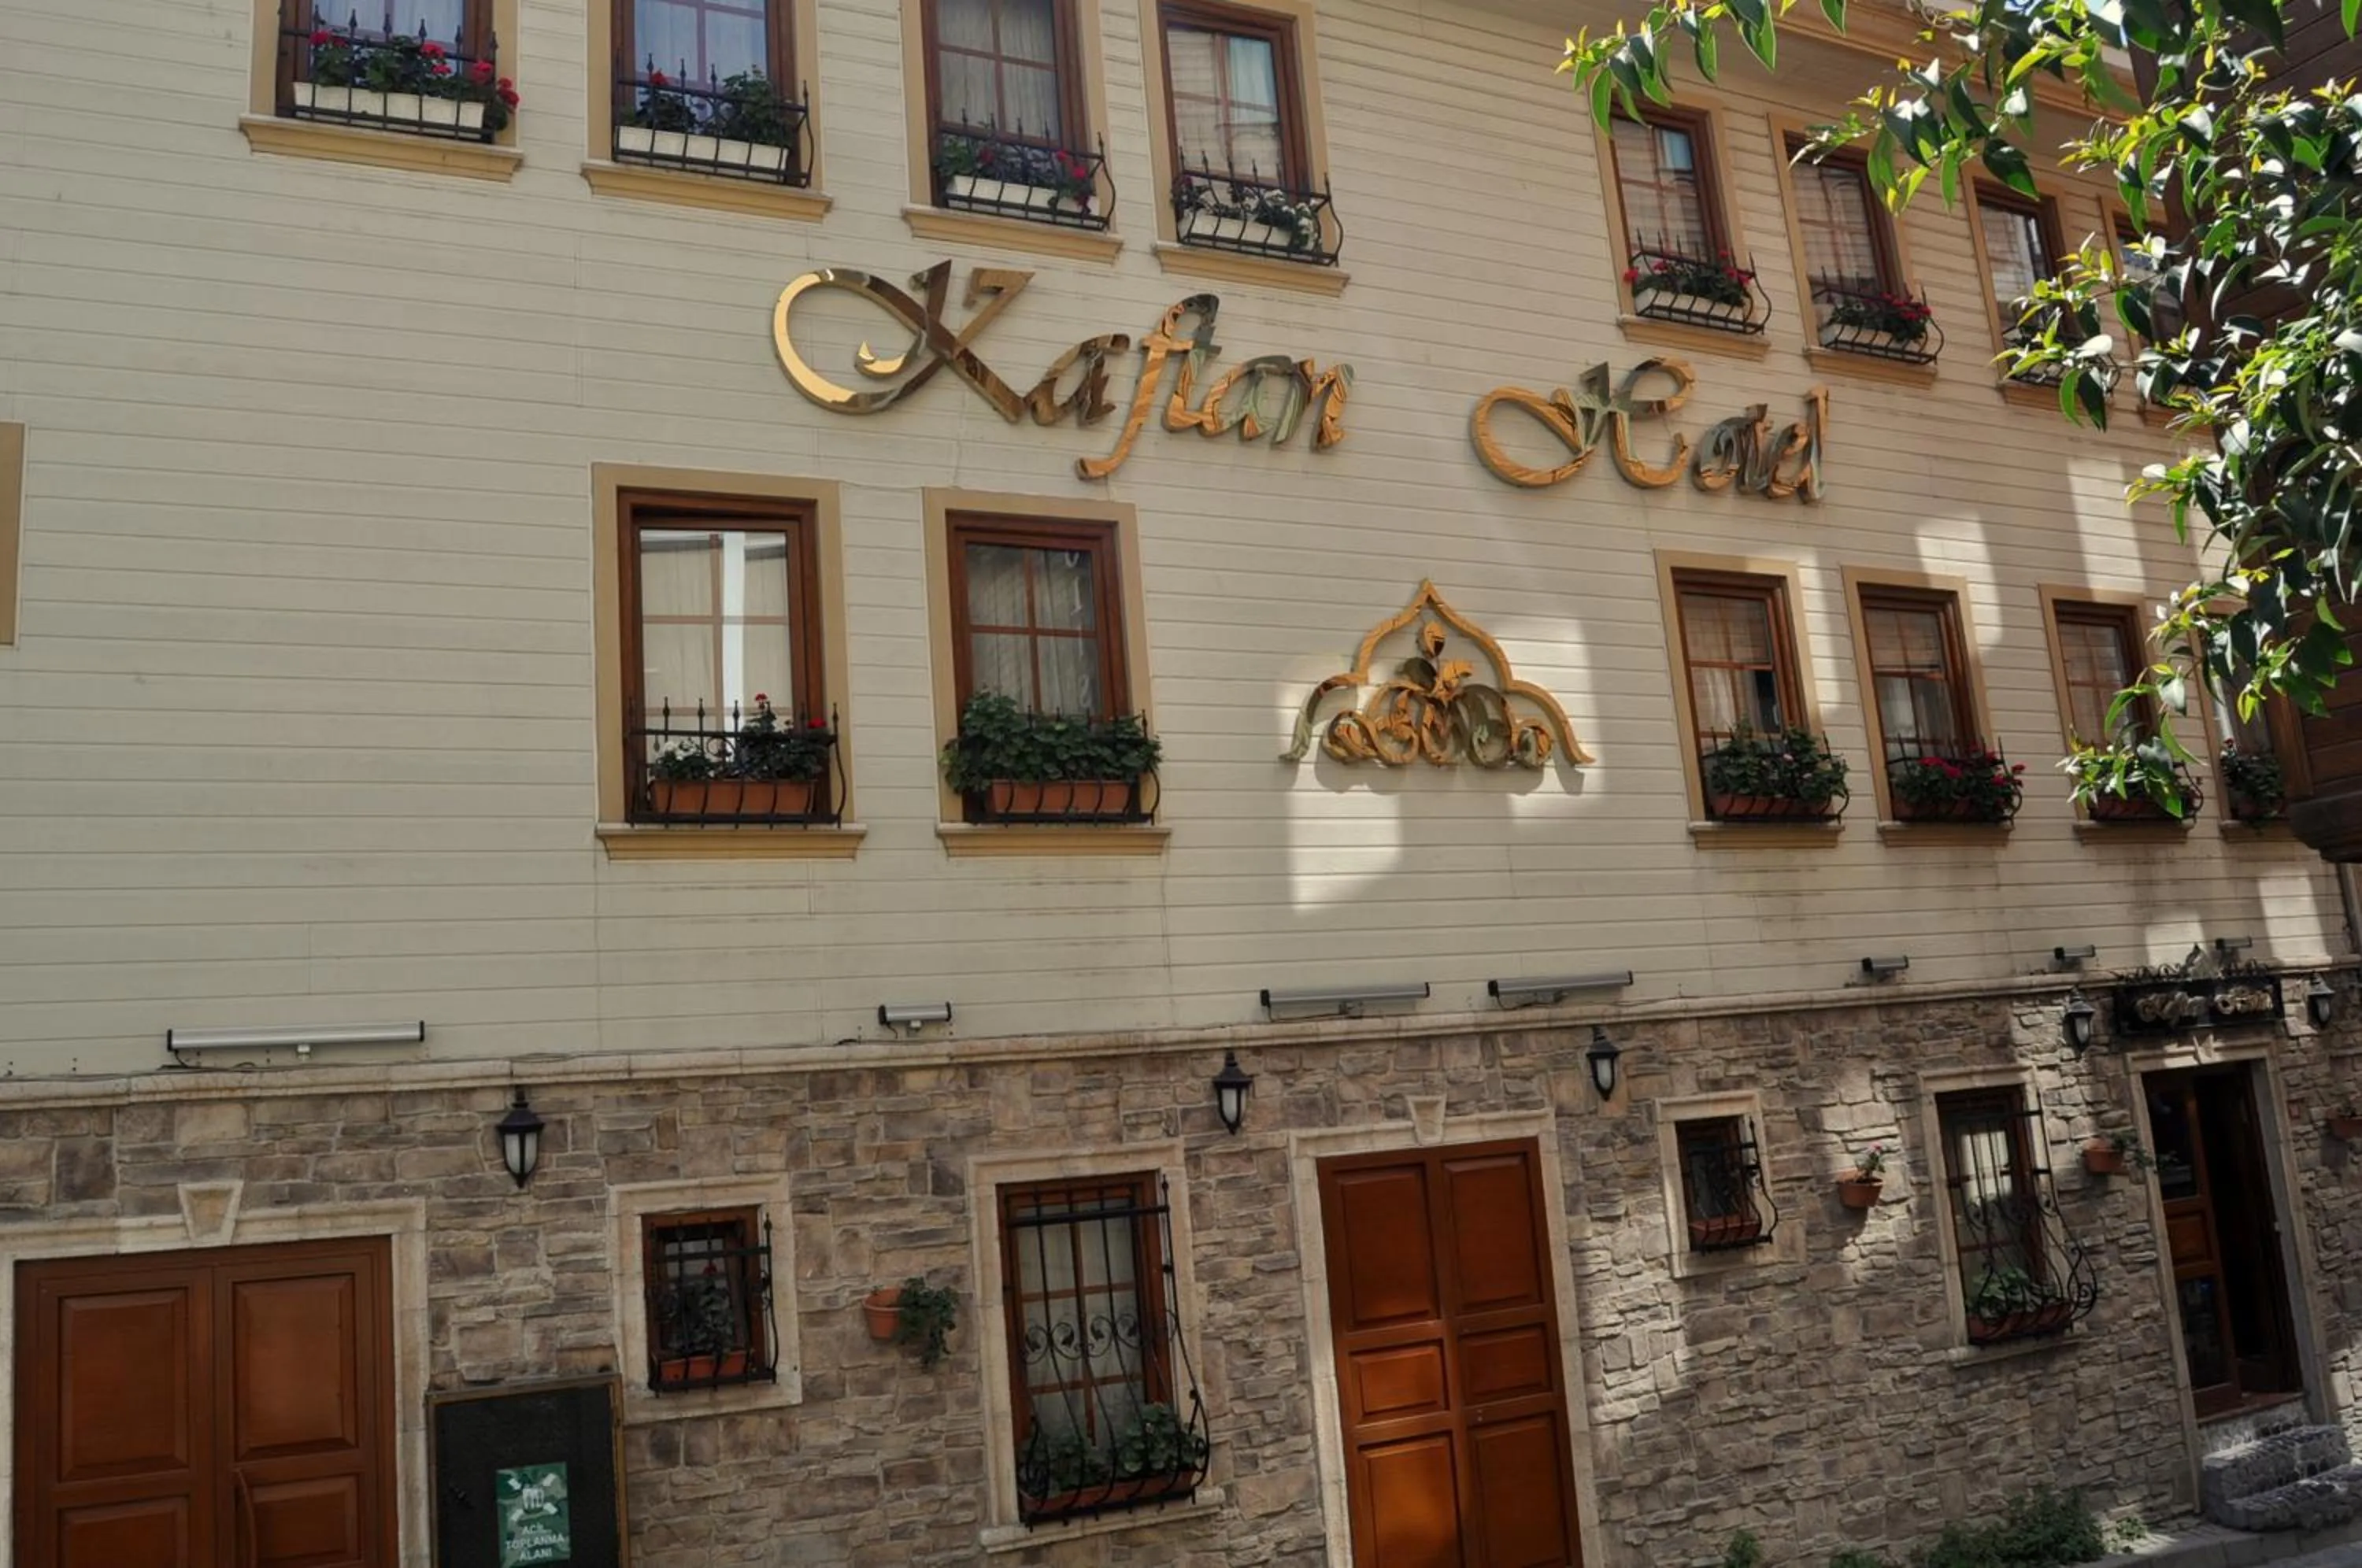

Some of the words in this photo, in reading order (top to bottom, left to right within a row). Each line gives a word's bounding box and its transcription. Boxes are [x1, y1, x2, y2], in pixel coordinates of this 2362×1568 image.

[772, 259, 1354, 480] Kaftan
[505, 1533, 565, 1550] TOPLANMA
[520, 1548, 553, 1561] ALANI
